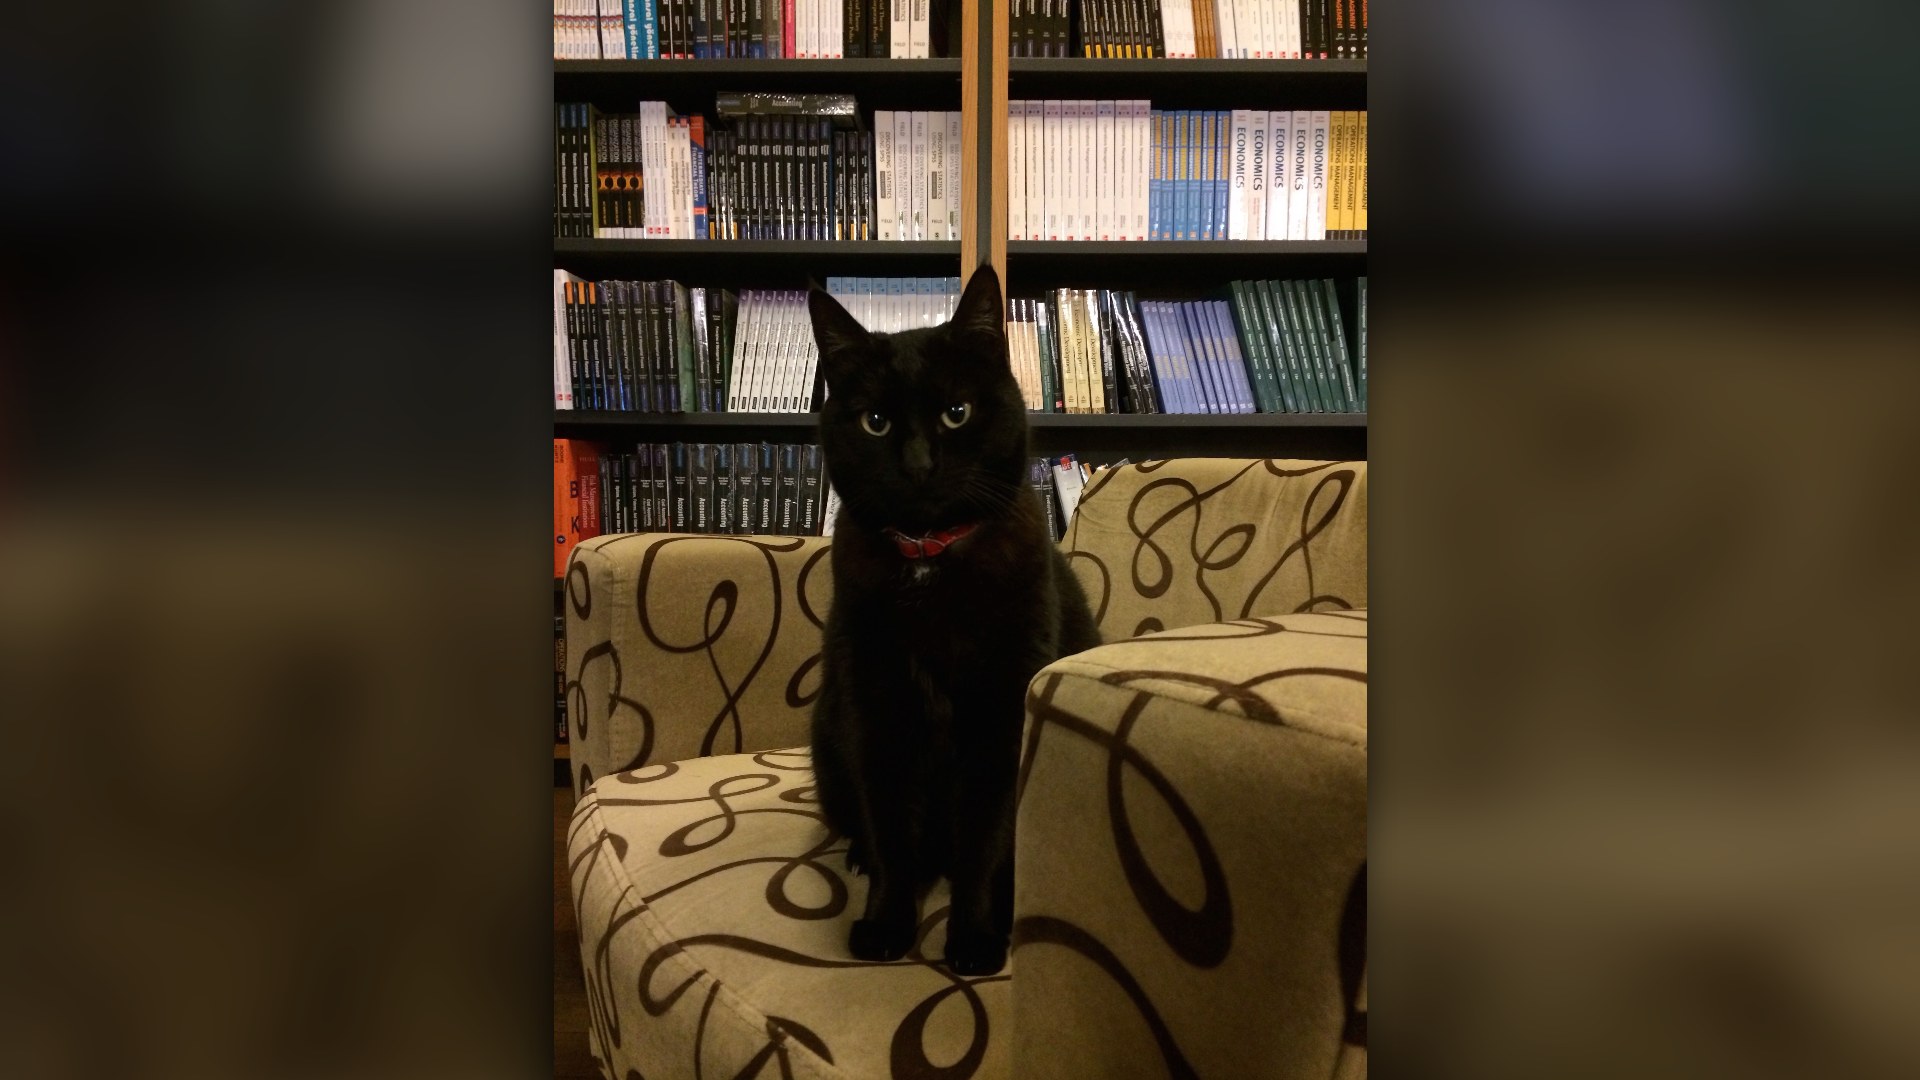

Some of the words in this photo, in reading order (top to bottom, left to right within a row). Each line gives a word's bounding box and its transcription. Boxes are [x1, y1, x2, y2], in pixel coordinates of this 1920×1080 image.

[772, 99, 803, 108] Accounting
[1236, 127, 1246, 188] ECONOMICS
[1253, 129, 1264, 191] ECONOMICS
[1275, 128, 1286, 188] ECONOMICS
[1295, 129, 1306, 190] ECONOMICS
[1313, 127, 1325, 189] ECONOMICS
[1333, 165, 1341, 210] MANAGEMENT
[1347, 165, 1355, 210] MANAGEMENT
[1063, 336, 1071, 374] Development
[1090, 338, 1099, 375] Development
[570, 480, 579, 498] B
[571, 516, 580, 534] K
[676, 497, 685, 527] Accounting
[698, 497, 706, 528] Accounting
[719, 498, 728, 528] Accounting
[741, 497, 749, 528] Accounting
[761, 498, 770, 528] Accounting
[782, 498, 792, 528] Accounting
[803, 498, 814, 528] Accounting
[557, 638, 565, 672] OPERATIONS
